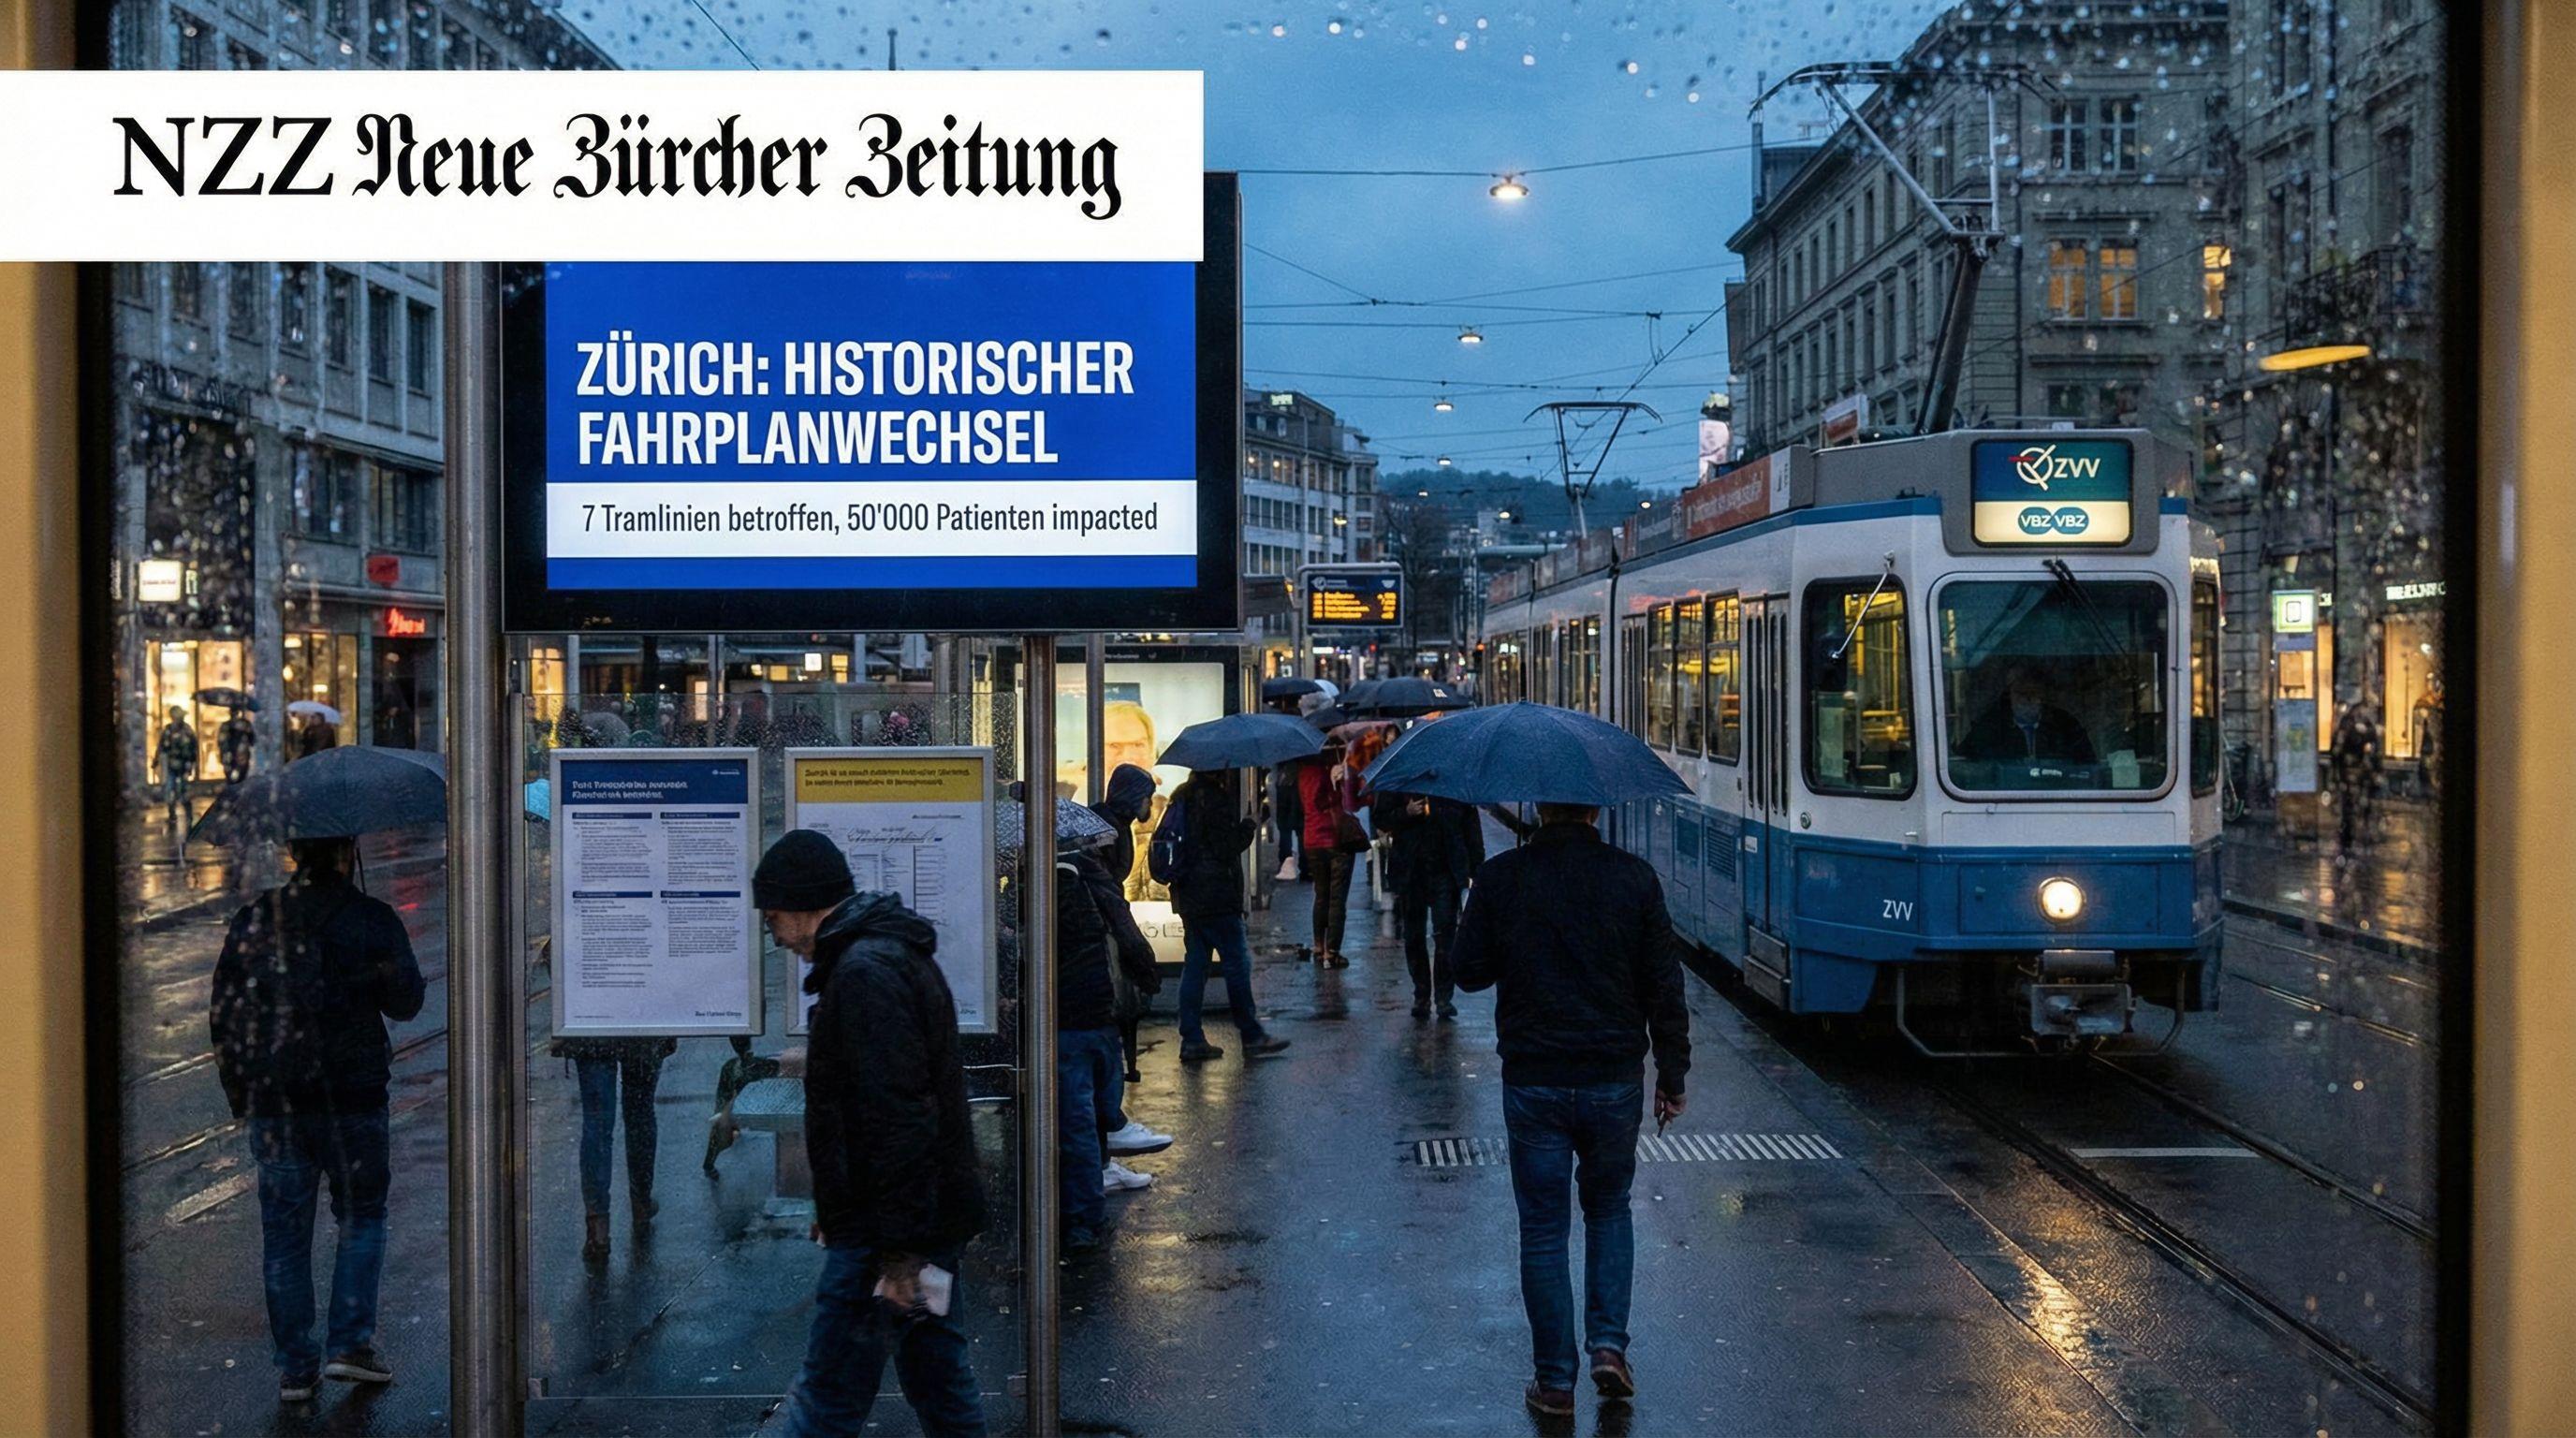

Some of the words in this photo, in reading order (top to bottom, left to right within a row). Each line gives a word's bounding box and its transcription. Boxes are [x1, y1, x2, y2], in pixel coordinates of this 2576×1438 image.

[577, 330, 769, 396] ZÜRICH:
[784, 340, 1134, 396] HISTORISCHER
[578, 409, 1059, 465] FAHRPLANWECHSEL
[2054, 457, 2101, 478] ZVV
[582, 506, 595, 532] 7
[601, 503, 720, 533] Tramlinien
[728, 503, 840, 536] betroffen,
[847, 503, 929, 533] 50'000
[937, 503, 1045, 532] Patienten
[1052, 502, 1158, 537] impacted
[2021, 515, 2052, 528] VBZ
[2055, 515, 2086, 528] VBZ
[1882, 899, 1913, 921] ZVV
